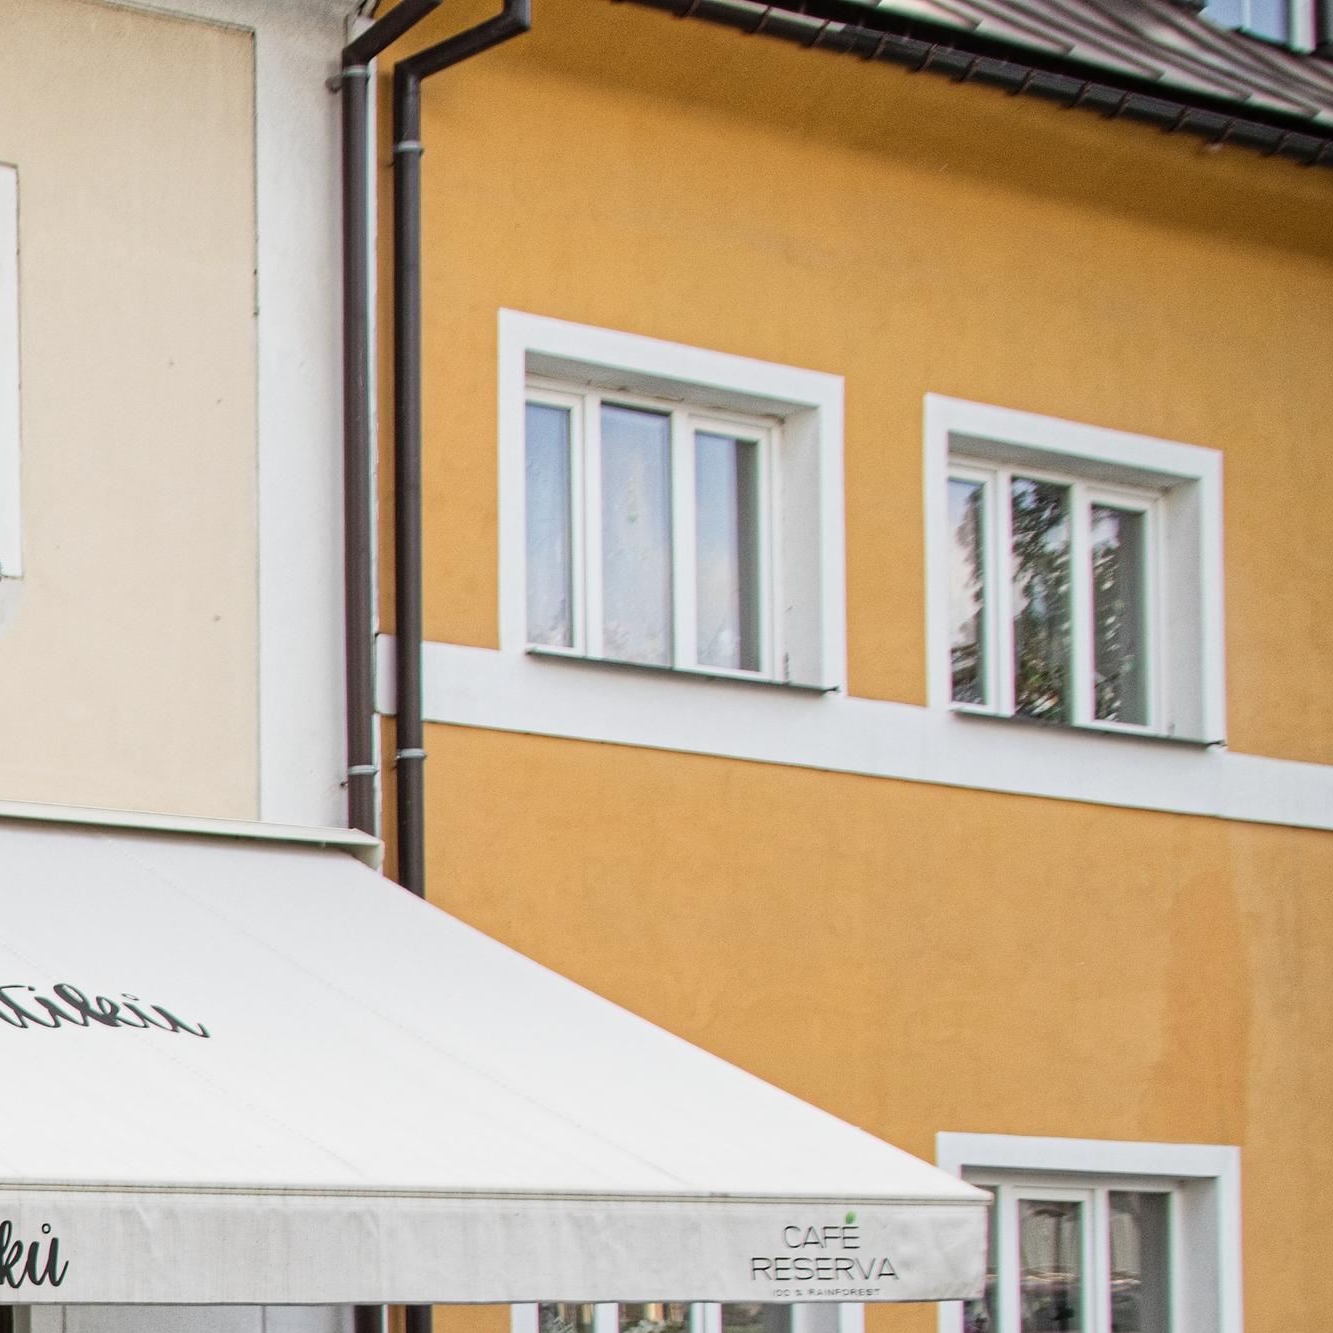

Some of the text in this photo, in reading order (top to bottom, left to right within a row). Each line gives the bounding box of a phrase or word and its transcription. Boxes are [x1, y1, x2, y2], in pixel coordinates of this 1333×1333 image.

[783, 1212, 861, 1249] CAFÉ
[750, 1257, 900, 1281] RESERVA
[808, 1288, 882, 1297] RAINFOREST
